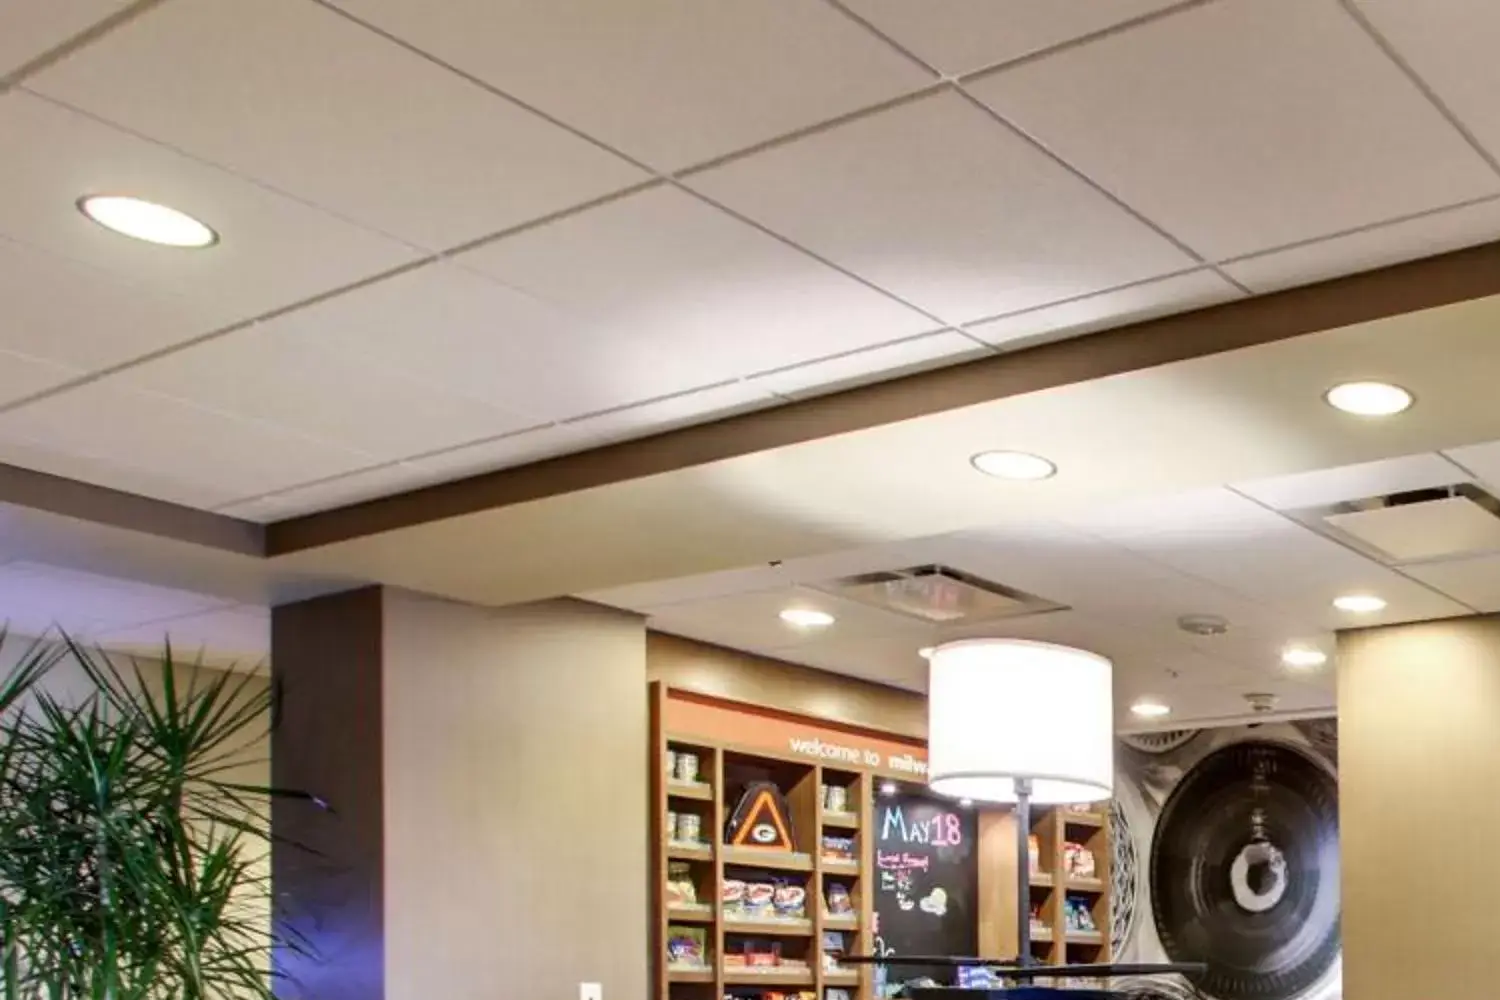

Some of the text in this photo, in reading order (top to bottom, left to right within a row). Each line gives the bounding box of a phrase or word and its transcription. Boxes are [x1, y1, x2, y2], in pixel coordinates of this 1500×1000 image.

[789, 737, 860, 764] welcome
[863, 750, 880, 767] to
[931, 812, 961, 846] 18
